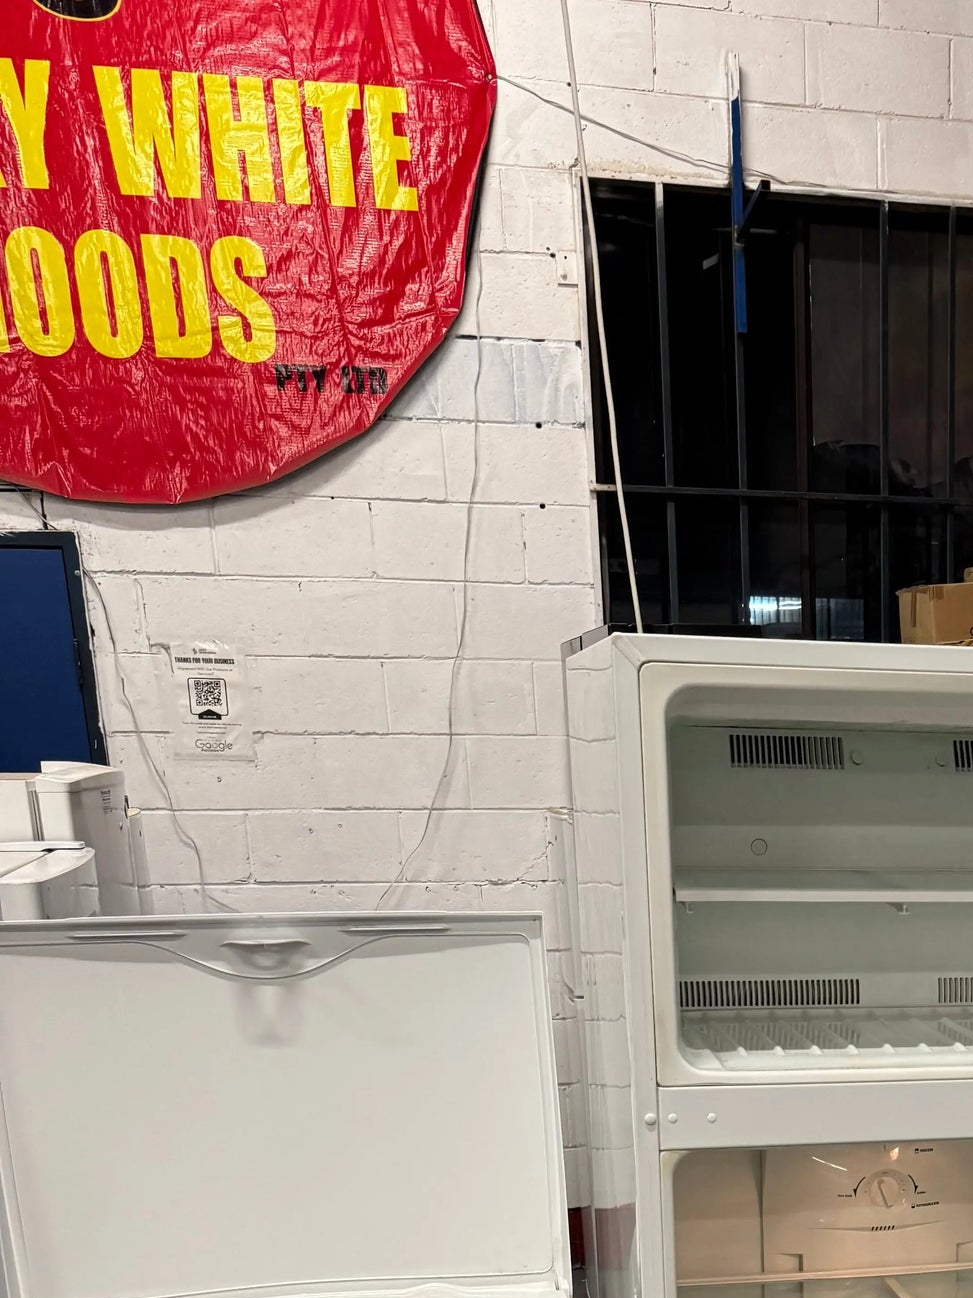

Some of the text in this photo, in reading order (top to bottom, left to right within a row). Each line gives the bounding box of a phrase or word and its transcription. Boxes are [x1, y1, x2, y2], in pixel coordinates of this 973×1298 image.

[0, 59, 418, 212] Y WHITE
[0, 226, 276, 363] OODS
[275, 364, 387, 394] PTY LTD
[194, 738, 233, 752] Google
